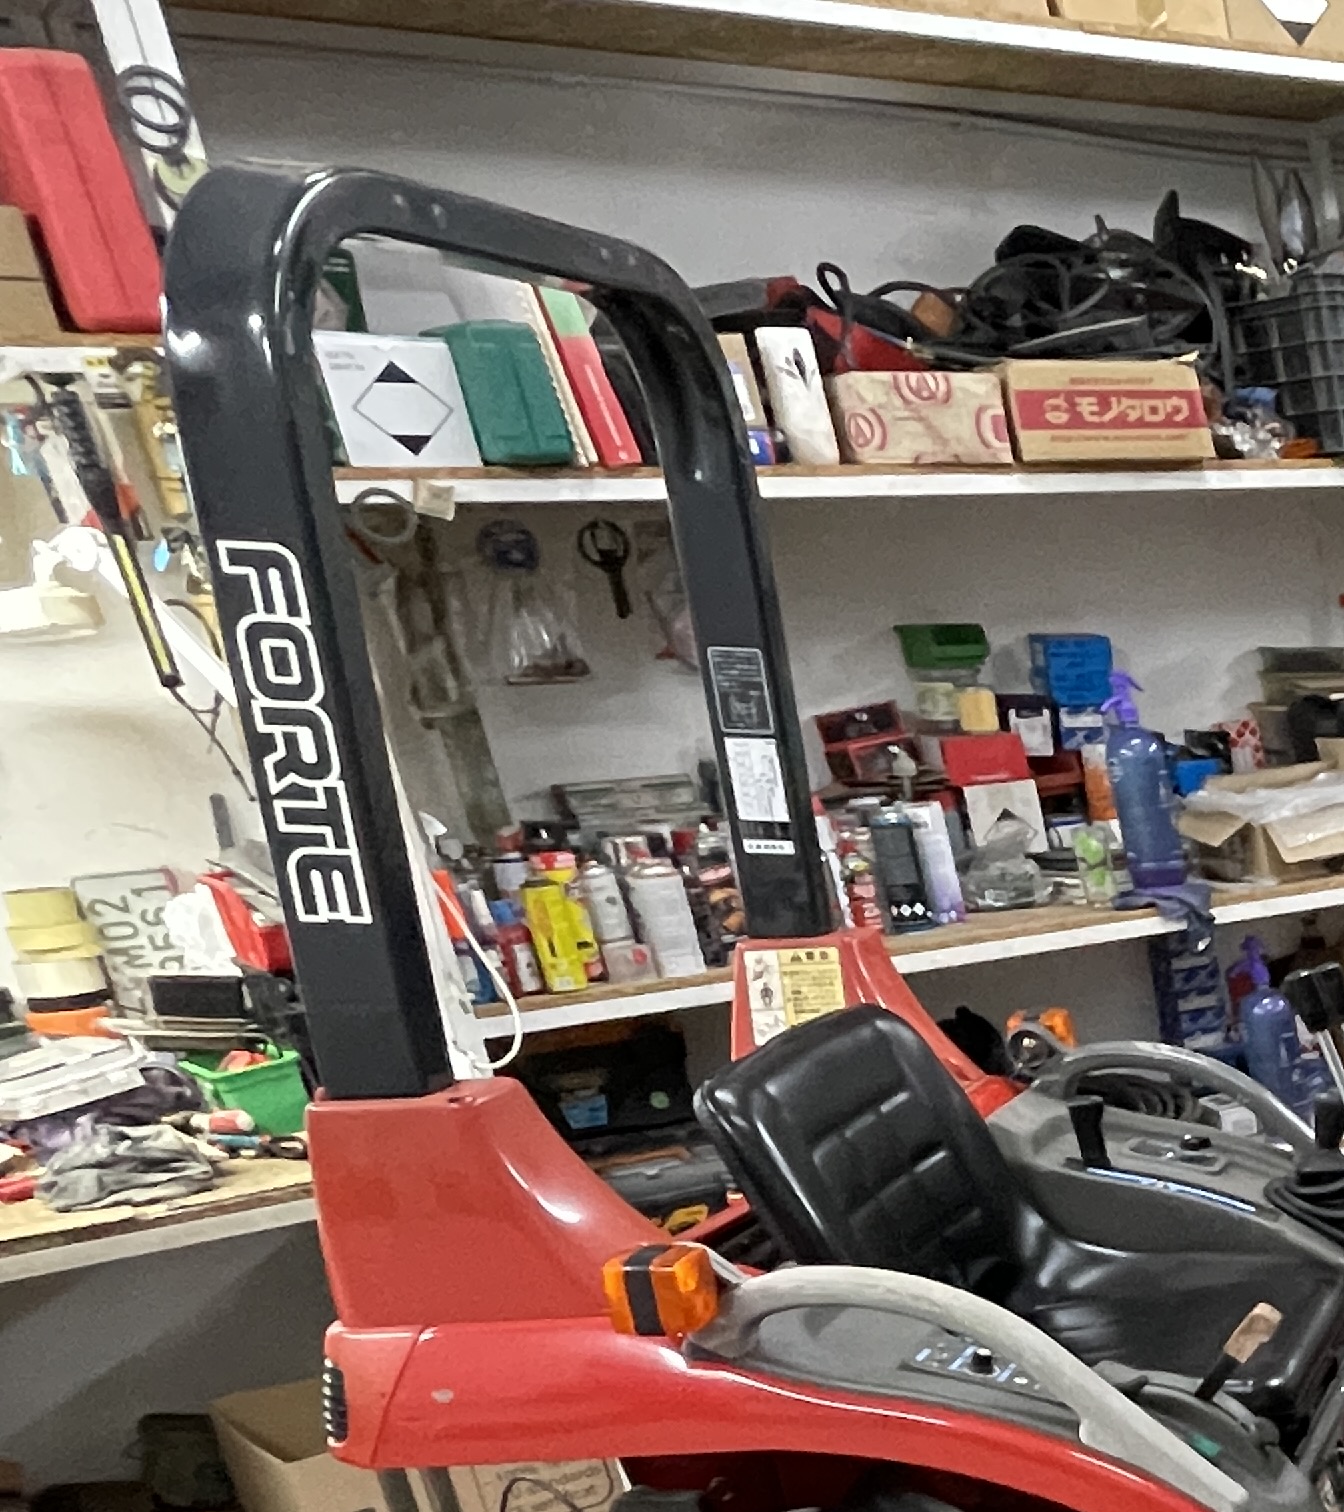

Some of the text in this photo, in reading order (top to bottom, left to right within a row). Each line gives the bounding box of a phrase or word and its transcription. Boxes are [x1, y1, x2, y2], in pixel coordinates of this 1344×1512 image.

[1075, 395, 1190, 423] モノタロウ
[216, 540, 373, 924] FORTE
